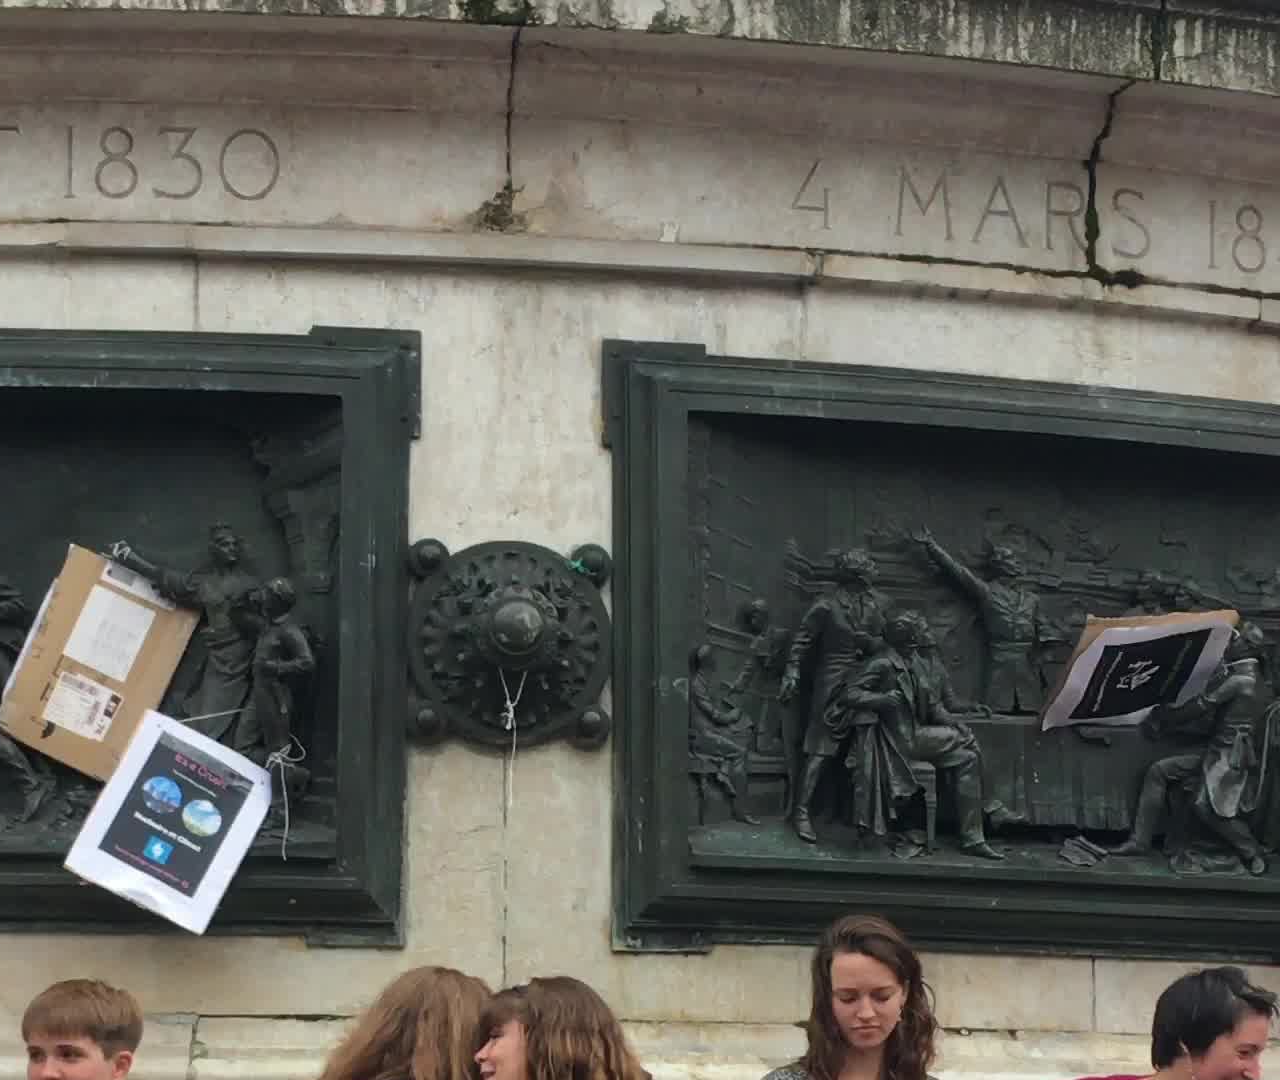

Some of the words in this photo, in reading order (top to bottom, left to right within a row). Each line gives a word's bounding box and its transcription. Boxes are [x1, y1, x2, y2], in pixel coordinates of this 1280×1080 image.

[63, 125, 281, 201] 1830
[791, 157, 832, 230] 4
[894, 166, 1151, 259] MARS
